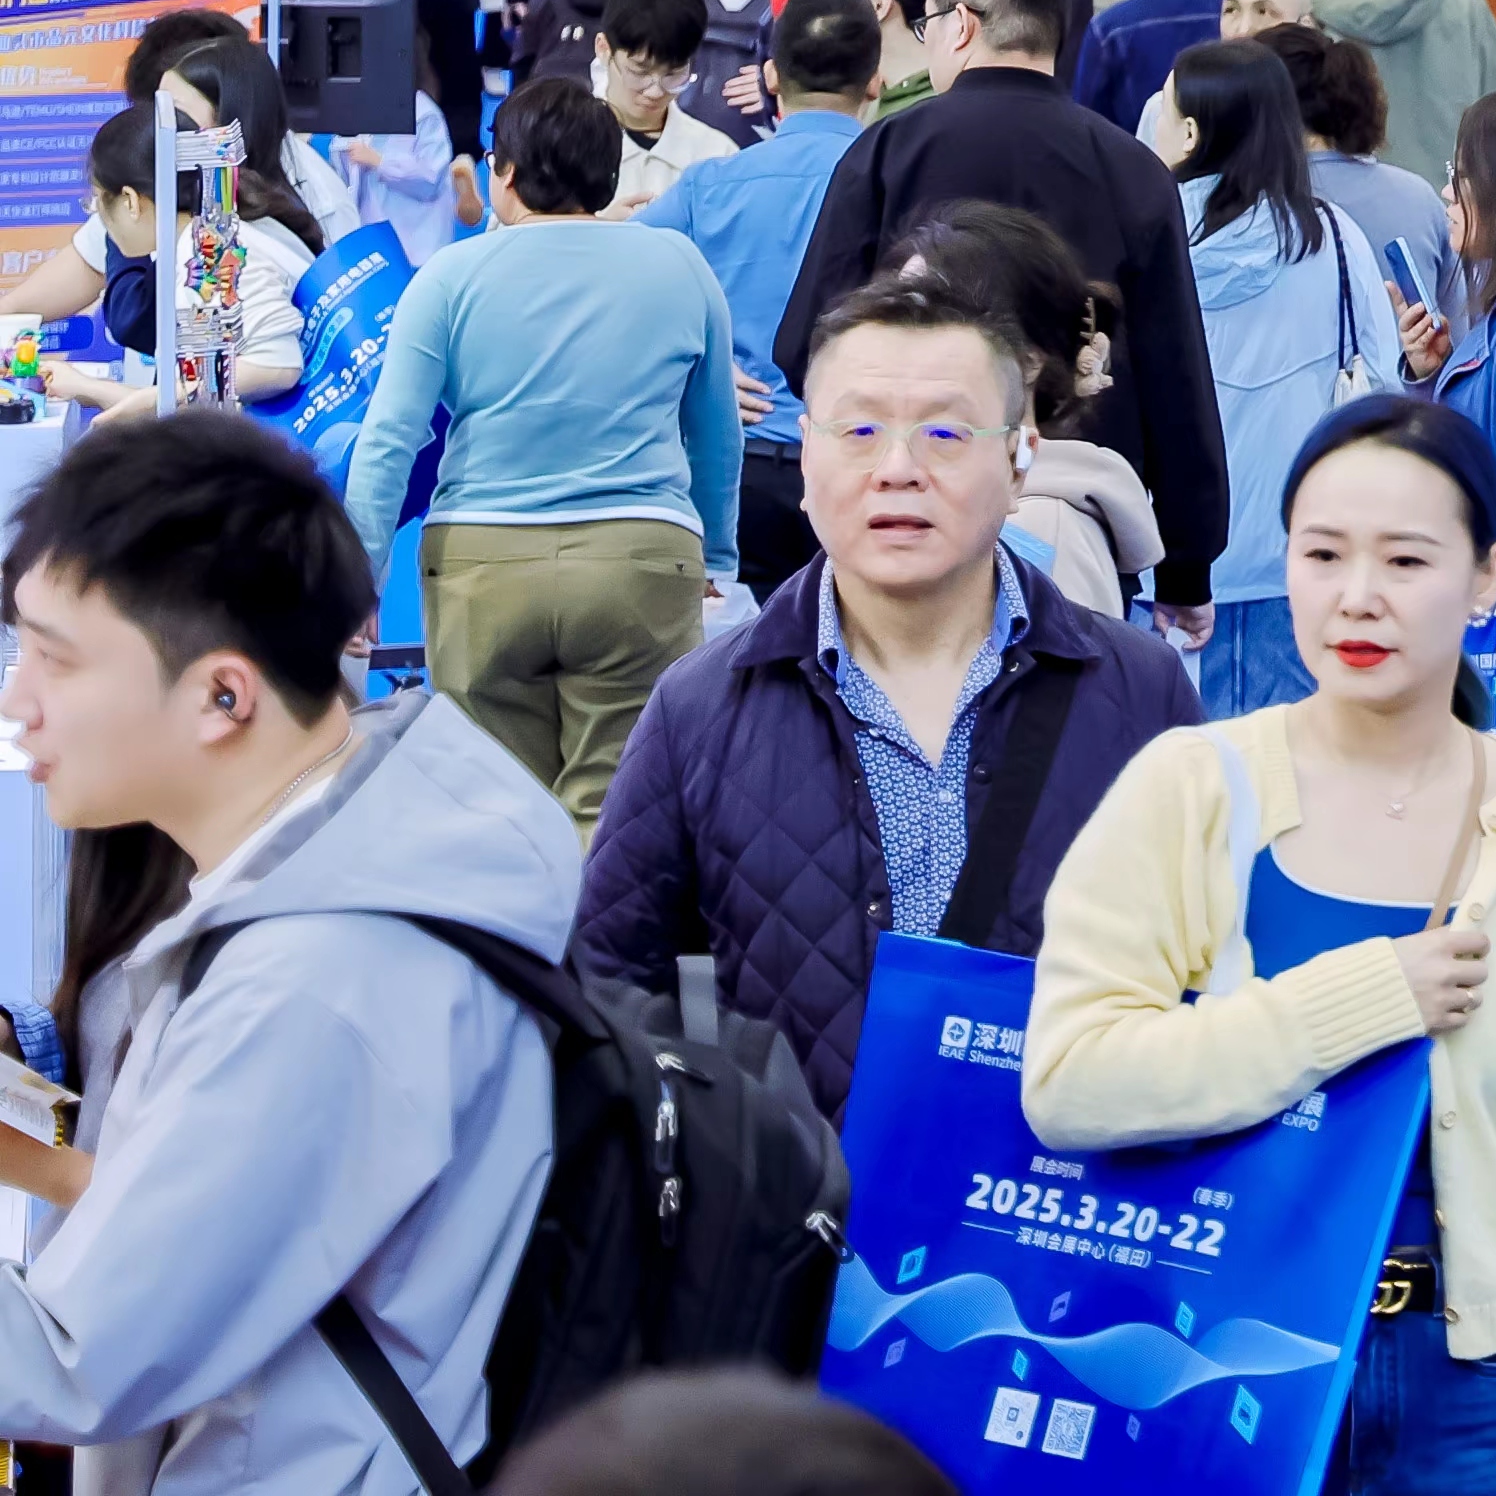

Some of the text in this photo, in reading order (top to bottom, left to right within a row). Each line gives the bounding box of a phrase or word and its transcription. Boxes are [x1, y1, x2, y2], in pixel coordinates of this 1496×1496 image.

[968, 1049, 1023, 1073] Shenzhe
[1282, 1112, 1319, 1132] EXPO
[965, 1173, 1226, 1258] 2025.3.20-22
